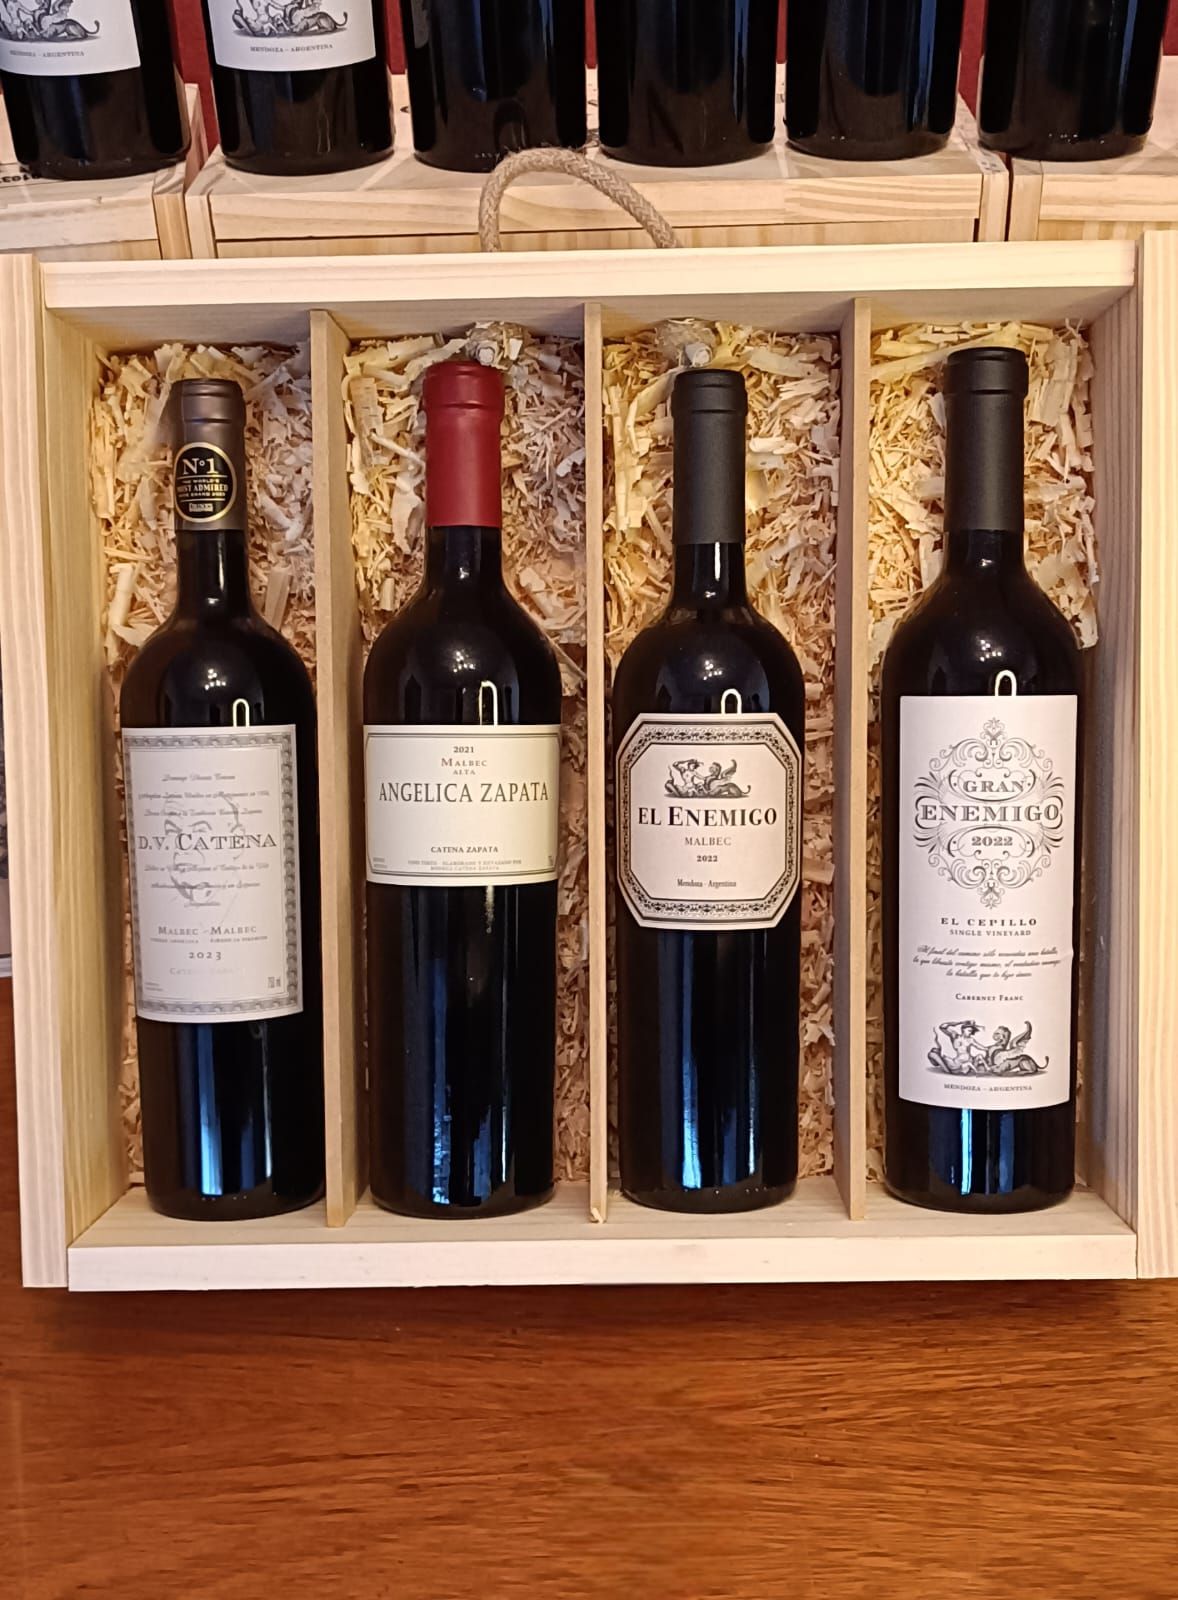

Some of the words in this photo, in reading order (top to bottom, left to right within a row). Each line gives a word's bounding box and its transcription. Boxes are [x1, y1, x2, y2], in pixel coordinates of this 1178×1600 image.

[290, 43, 333, 52] ARGENTINA
[193, 483, 228, 492] ADMIRED
[453, 746, 475, 754] 2021
[962, 780, 1025, 793] GRAN
[379, 782, 473, 803] ANGELICA
[480, 781, 549, 803] ZAPATA
[638, 807, 662, 826] EL
[667, 806, 777, 827] ENEMIGO
[920, 803, 1060, 822] ENEMIGO
[136, 836, 169, 851] D.V.
[174, 832, 277, 851] CATENA
[684, 837, 732, 846] MALBEC
[971, 836, 1013, 847] 2022
[430, 846, 465, 854] CATENA
[466, 846, 499, 854] ZAPATA
[696, 855, 718, 863] 2022
[677, 879, 703, 888] Mendoza
[708, 879, 737, 889] Argentina
[940, 917, 960, 926] EL
[967, 918, 1037, 927] CEPILLO
[157, 925, 199, 936] MALBEC
[209, 926, 257, 936] MALBEC
[188, 951, 222, 961] 2023
[954, 992, 996, 1001] CABERNET
[998, 993, 1025, 1002] FRANC
[943, 1083, 981, 1091] MENDOZA
